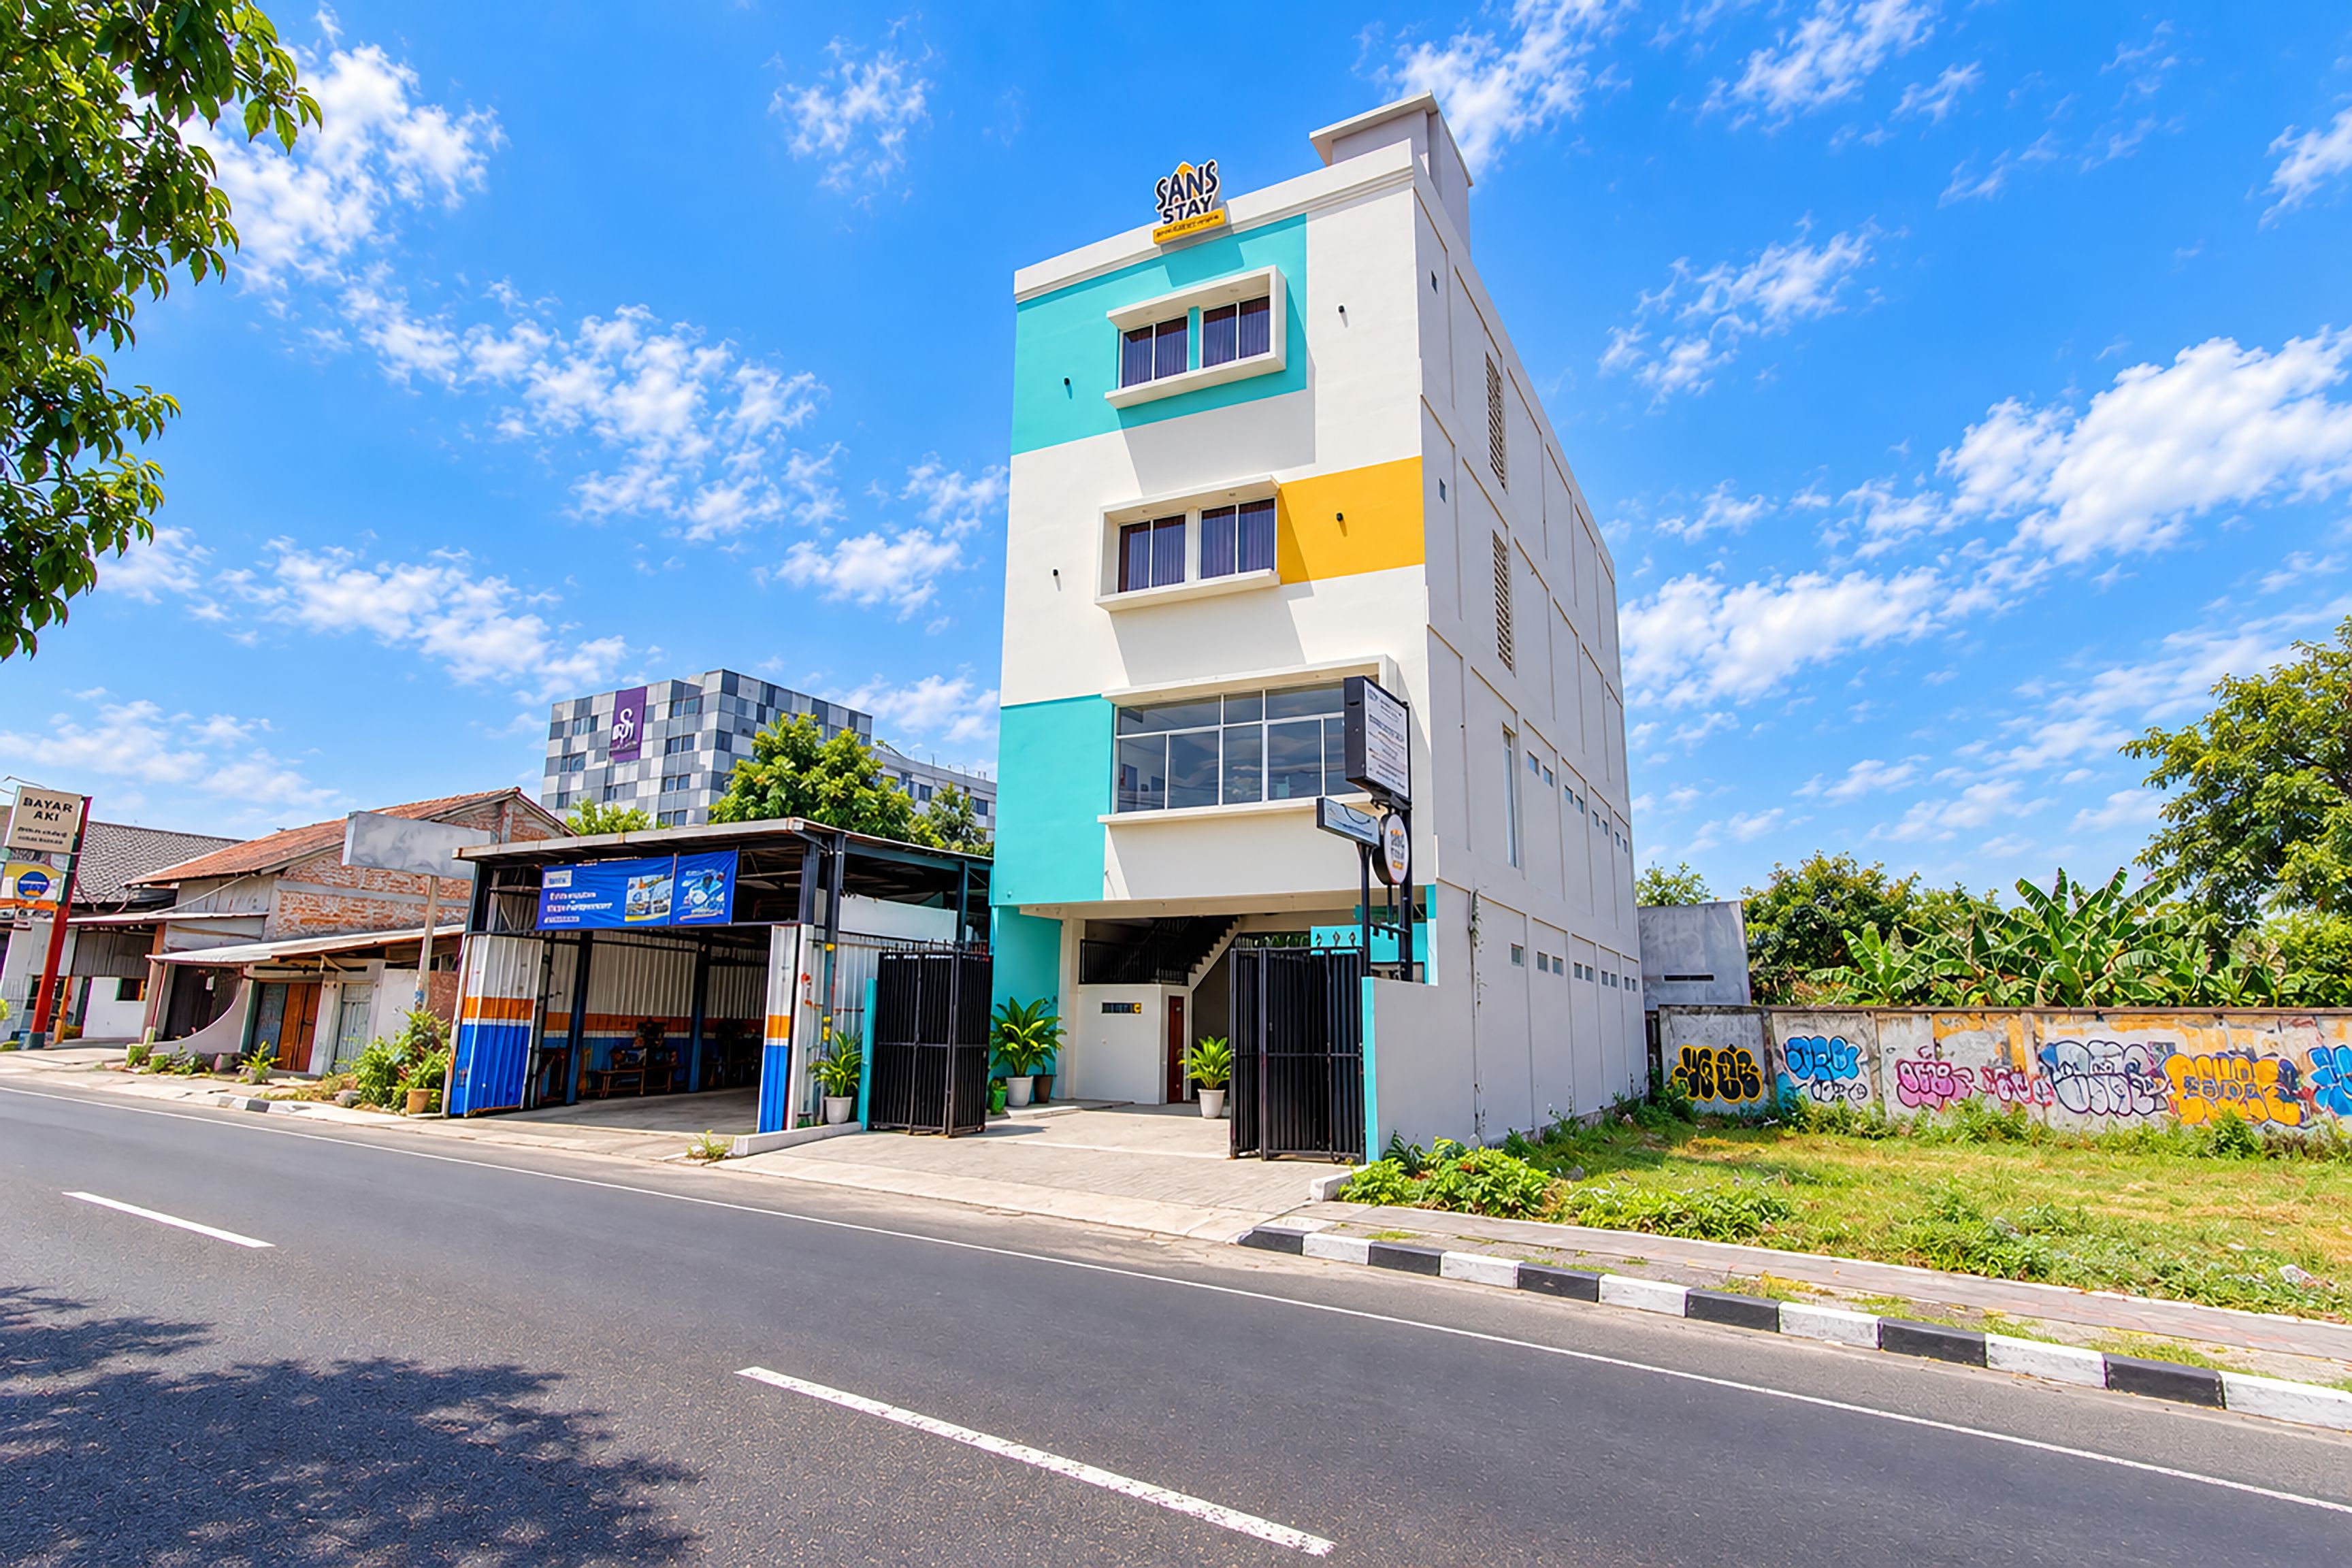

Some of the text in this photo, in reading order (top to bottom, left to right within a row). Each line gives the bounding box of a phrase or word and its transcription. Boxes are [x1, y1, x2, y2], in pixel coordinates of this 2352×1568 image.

[1156, 160, 1218, 211] SANS
[1162, 195, 1212, 225] STAY
[33, 811, 59, 821] AKI
